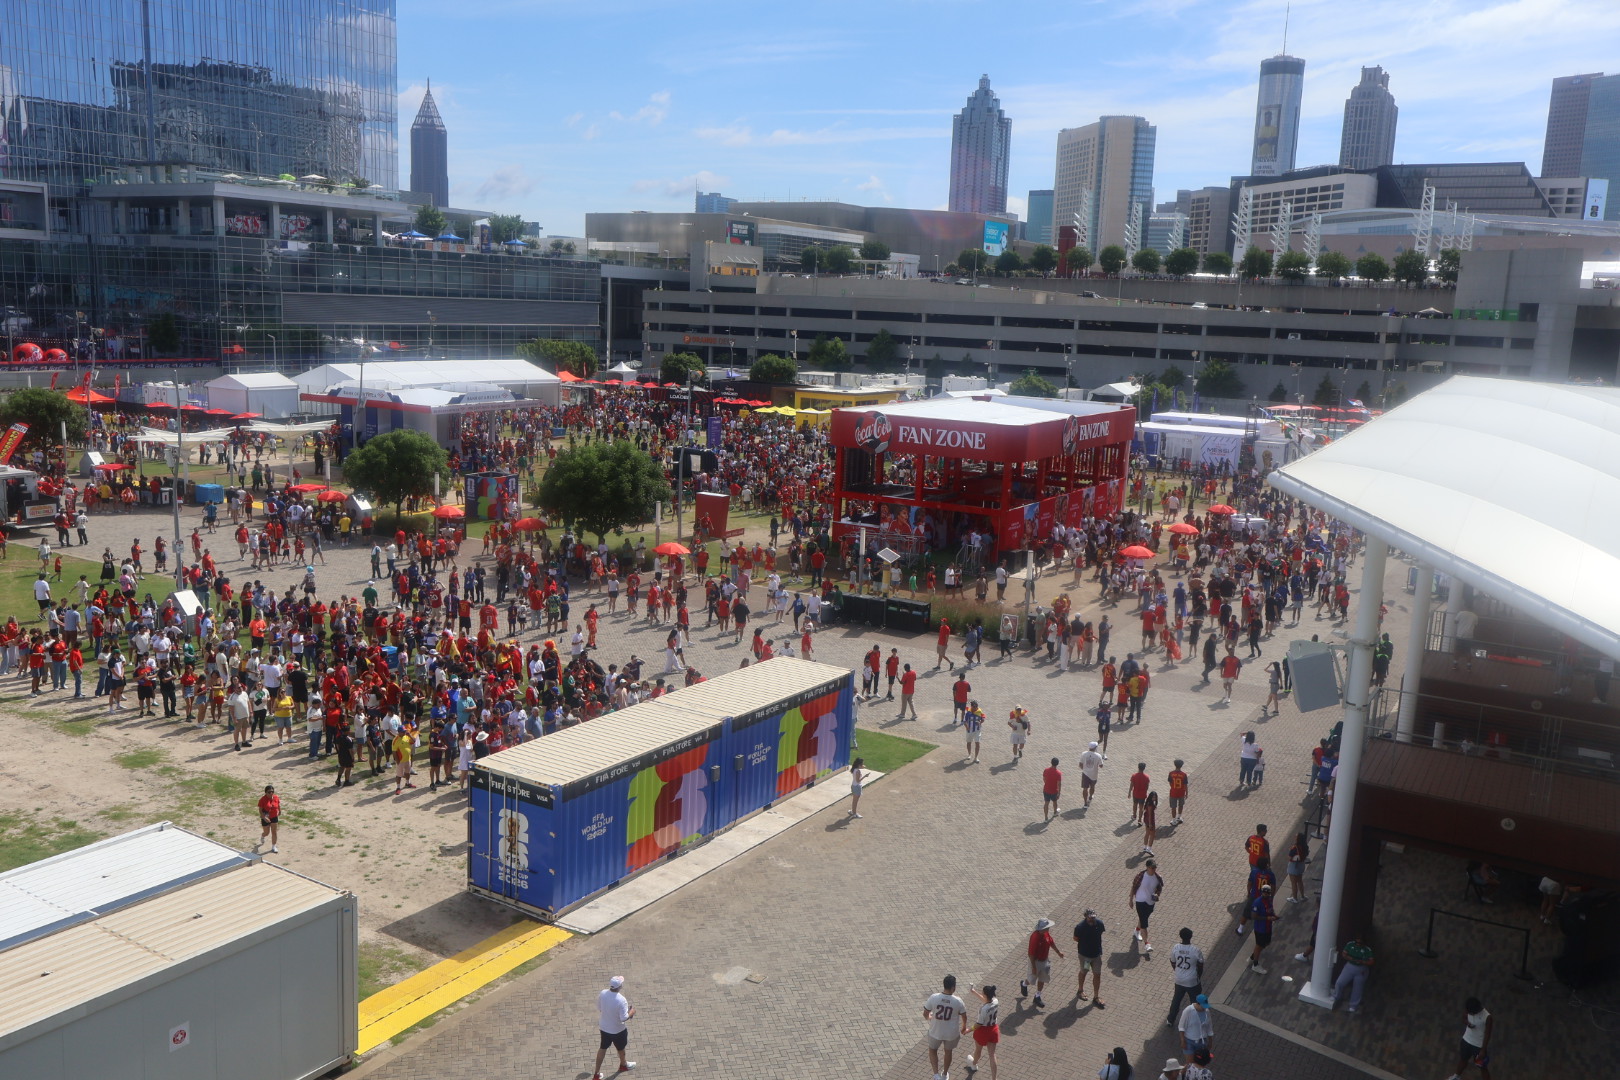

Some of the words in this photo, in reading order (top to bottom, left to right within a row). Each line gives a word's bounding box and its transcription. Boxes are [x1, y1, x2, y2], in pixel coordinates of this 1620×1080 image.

[898, 425, 933, 445] FAN
[935, 428, 987, 450] ZONE
[1079, 423, 1093, 441] FAN
[1092, 420, 1110, 439] ZONE
[595, 772, 609, 784] FIFA
[610, 764, 628, 778] STORE
[491, 780, 505, 790] FIFA
[507, 783, 531, 798] STORE
[536, 794, 548, 802] VISA
[581, 821, 604, 836] WORLD
[603, 815, 614, 827] CUP
[592, 812, 605, 824] FIFA
[586, 827, 607, 841] 2026
[1177, 955, 1191, 970] 25
[935, 1004, 953, 1021] 20
